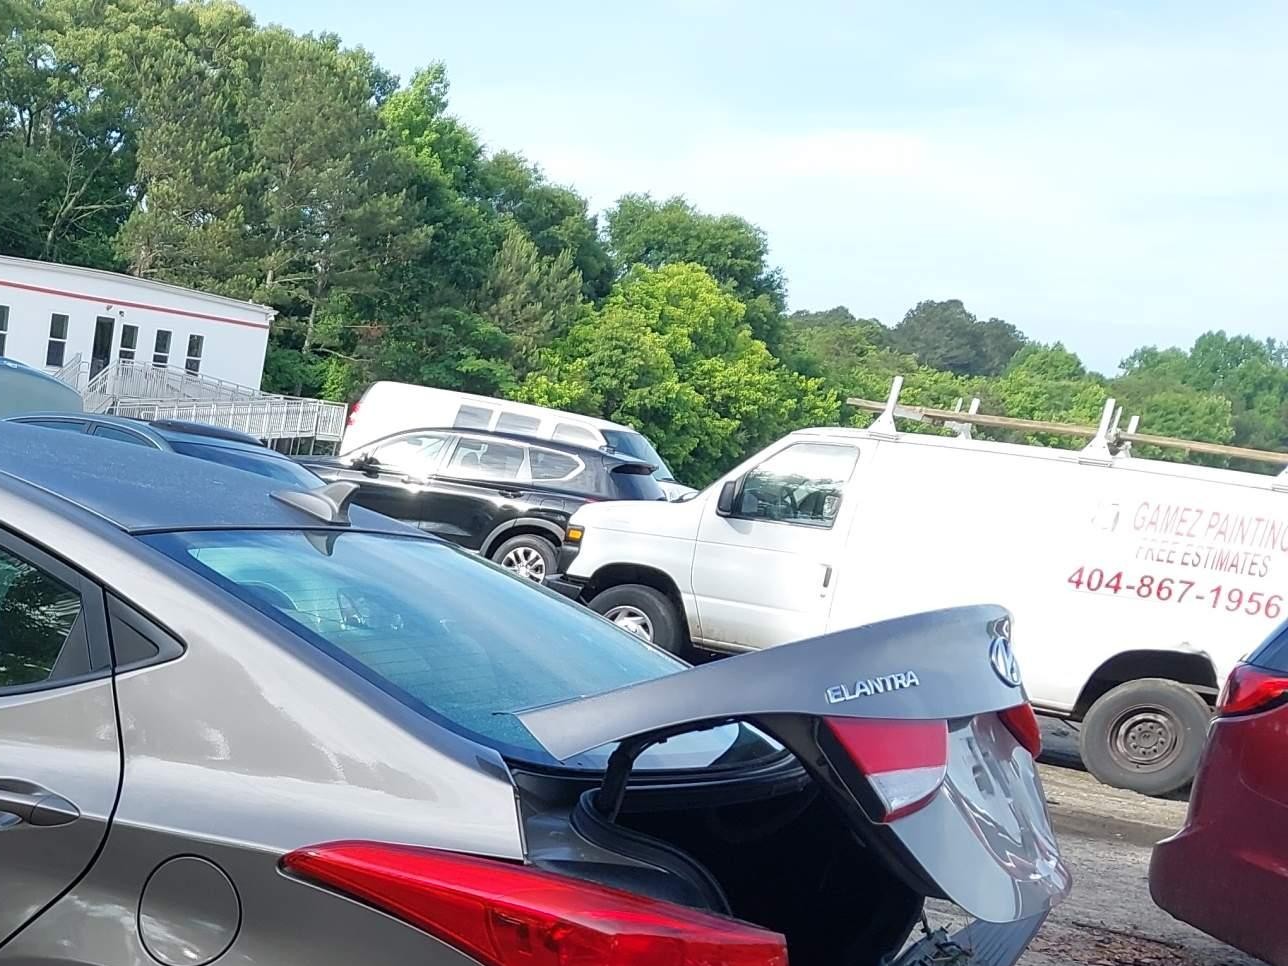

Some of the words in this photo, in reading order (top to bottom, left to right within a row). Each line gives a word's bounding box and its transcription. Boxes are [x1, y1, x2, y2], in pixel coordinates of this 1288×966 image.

[1133, 501, 1204, 539] GAMEZ
[1135, 537, 1180, 565] FREE
[1180, 543, 1272, 578] ESTIMATES
[1067, 565, 1284, 619] 404-867-1956
[824, 670, 920, 704] ELANTRA
